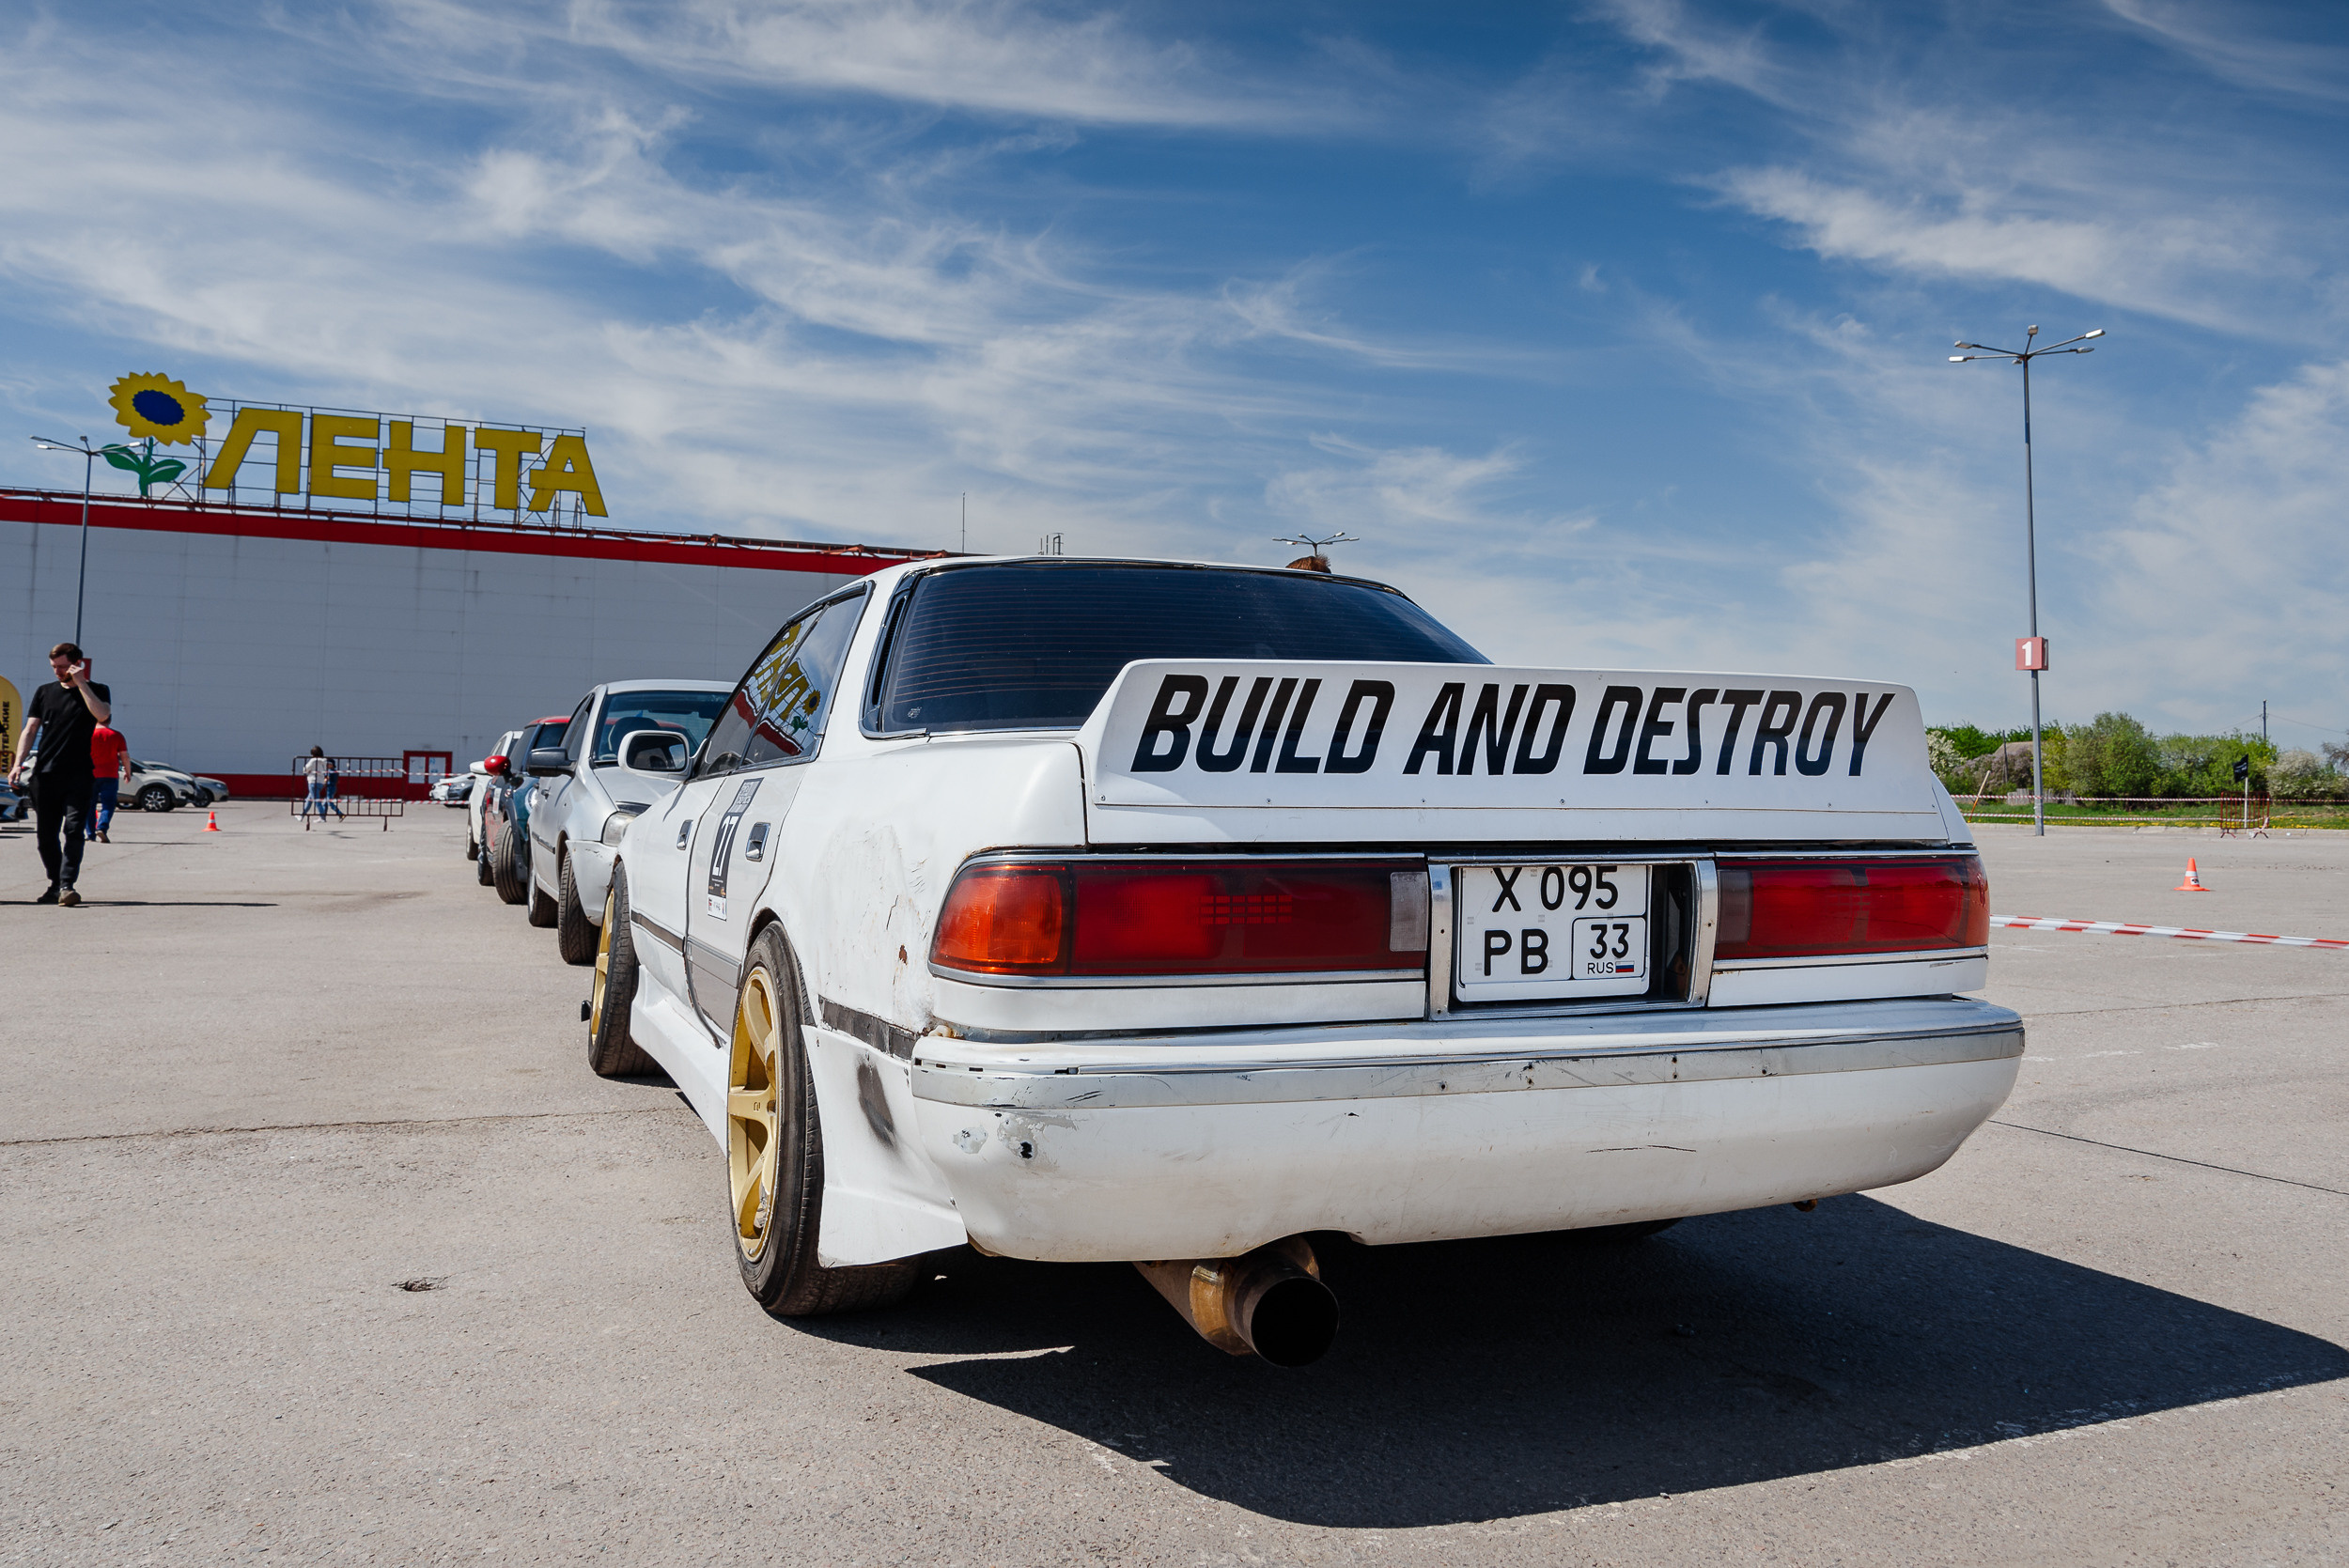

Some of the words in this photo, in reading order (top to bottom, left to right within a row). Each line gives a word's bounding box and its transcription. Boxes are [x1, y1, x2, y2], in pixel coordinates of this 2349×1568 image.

[202, 407, 609, 518] ЛЕНТА
[2022, 641, 2031, 666] 1
[1130, 674, 1395, 773] BUILD
[1402, 682, 1576, 775] AND
[1583, 685, 1896, 776] DESTROY
[712, 815, 739, 877] 27
[1540, 865, 1619, 911] 095
[1590, 924, 1629, 959] 33
[1587, 962, 1614, 974] RUS
